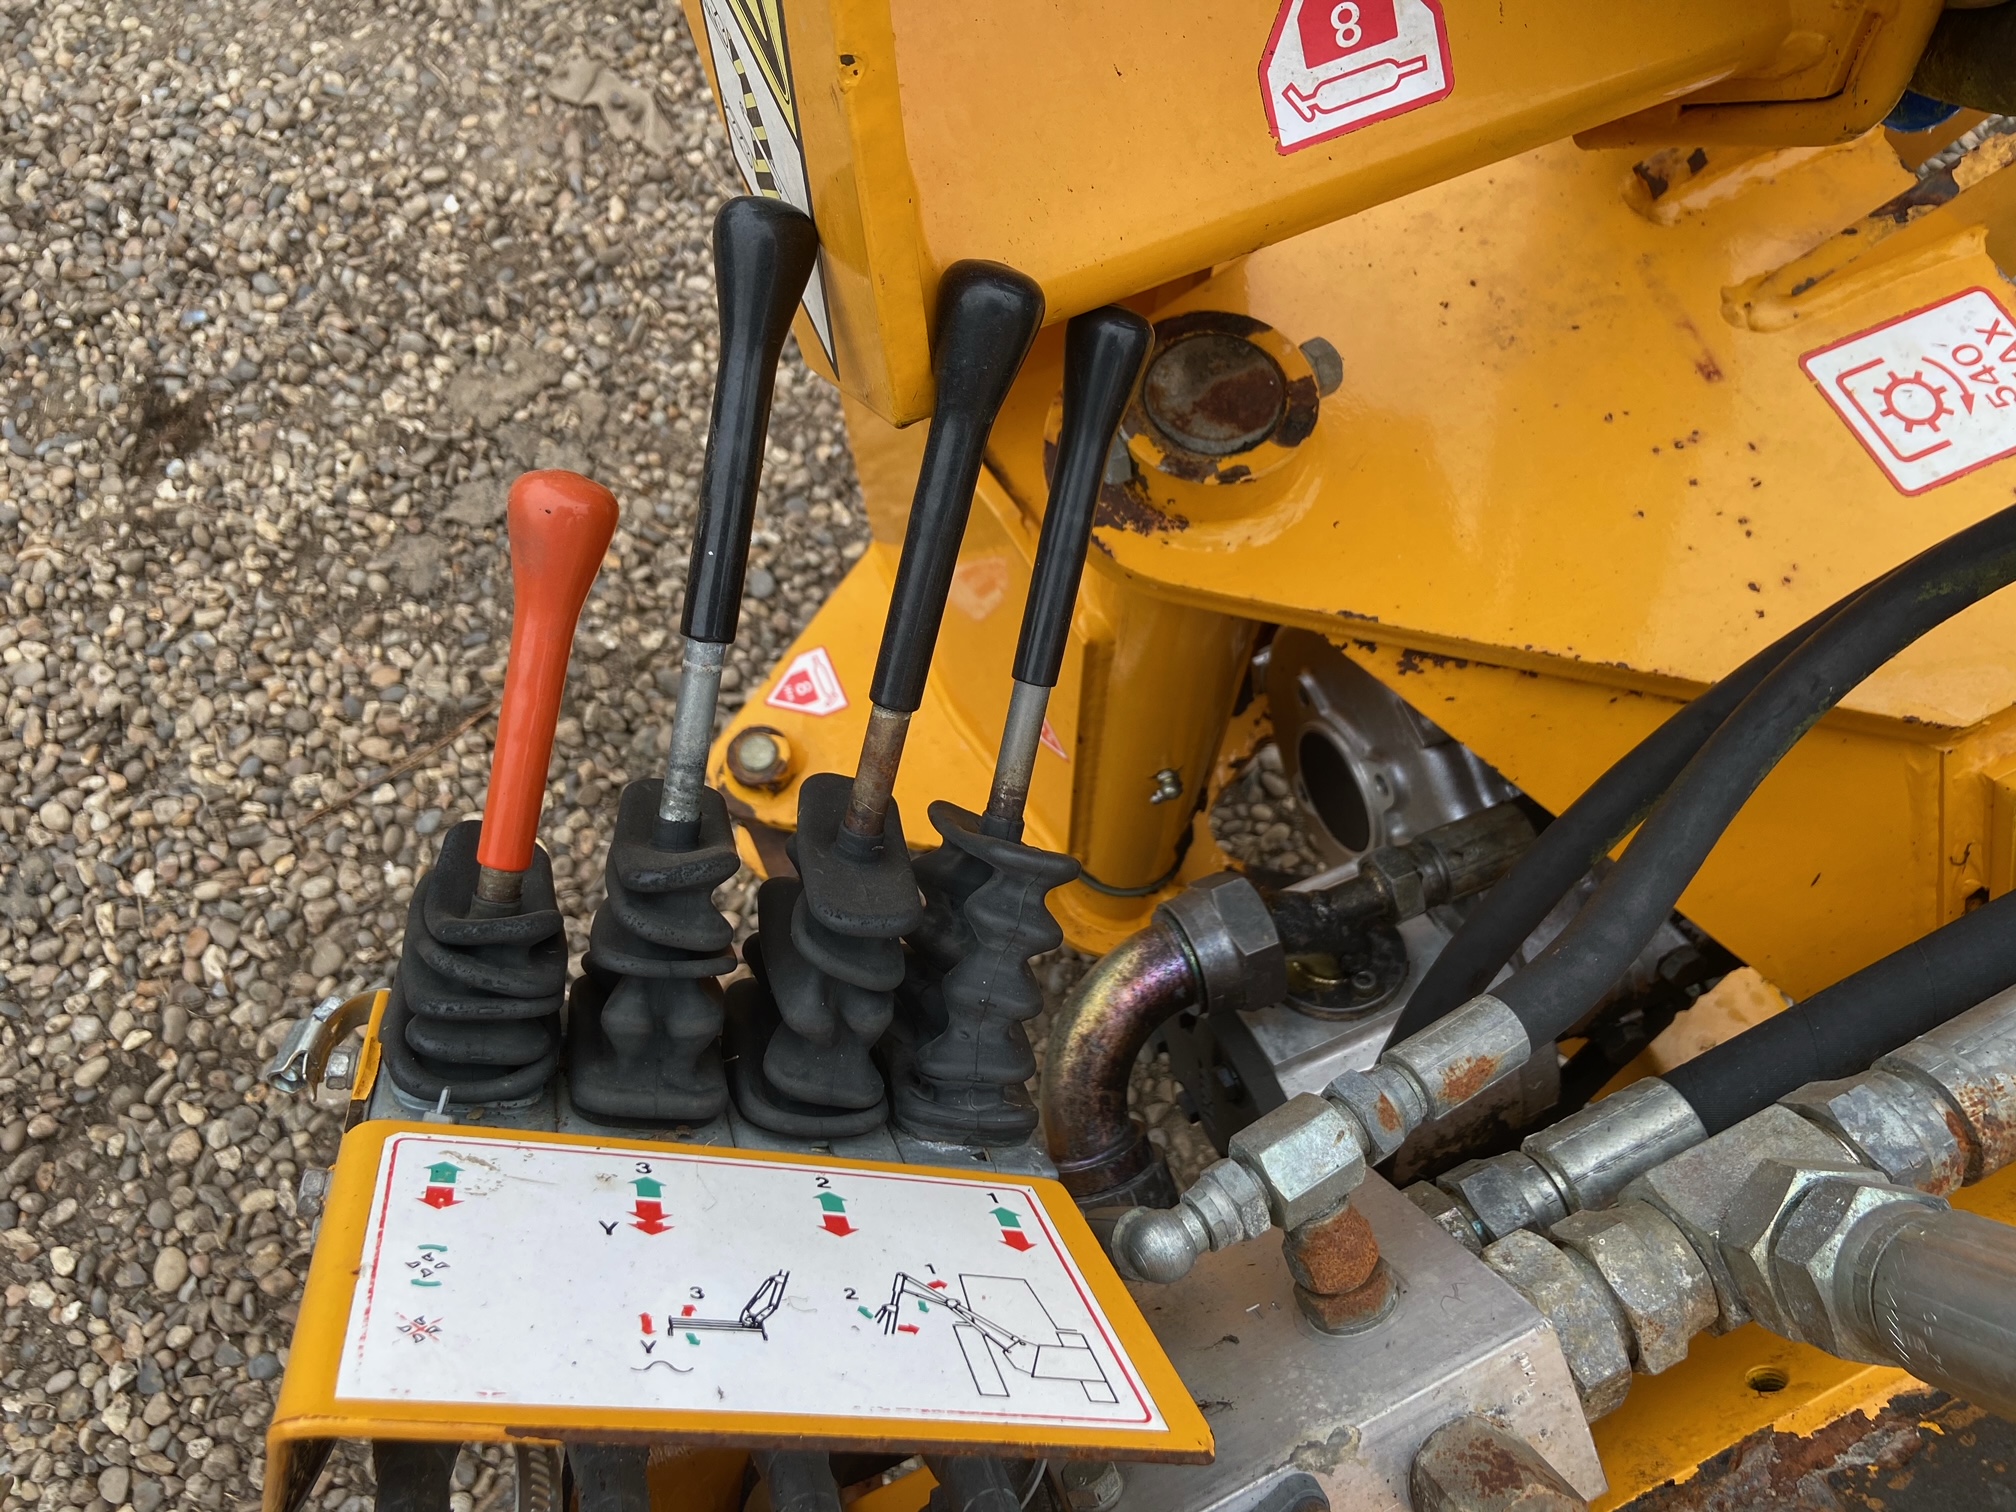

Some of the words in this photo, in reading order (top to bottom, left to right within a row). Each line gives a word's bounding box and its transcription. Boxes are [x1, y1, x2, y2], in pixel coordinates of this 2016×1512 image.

[1330, 1, 1362, 48] 8
[1951, 343, 2016, 408] 540
[635, 1162, 653, 1174] 3
[815, 1176, 831, 1189] 2
[986, 1192, 999, 1204] 1
[598, 1220, 619, 1236] Y
[924, 1263, 936, 1275] 1
[689, 1286, 705, 1299] 3
[843, 1287, 859, 1300] 2
[640, 1339, 657, 1354] Y
